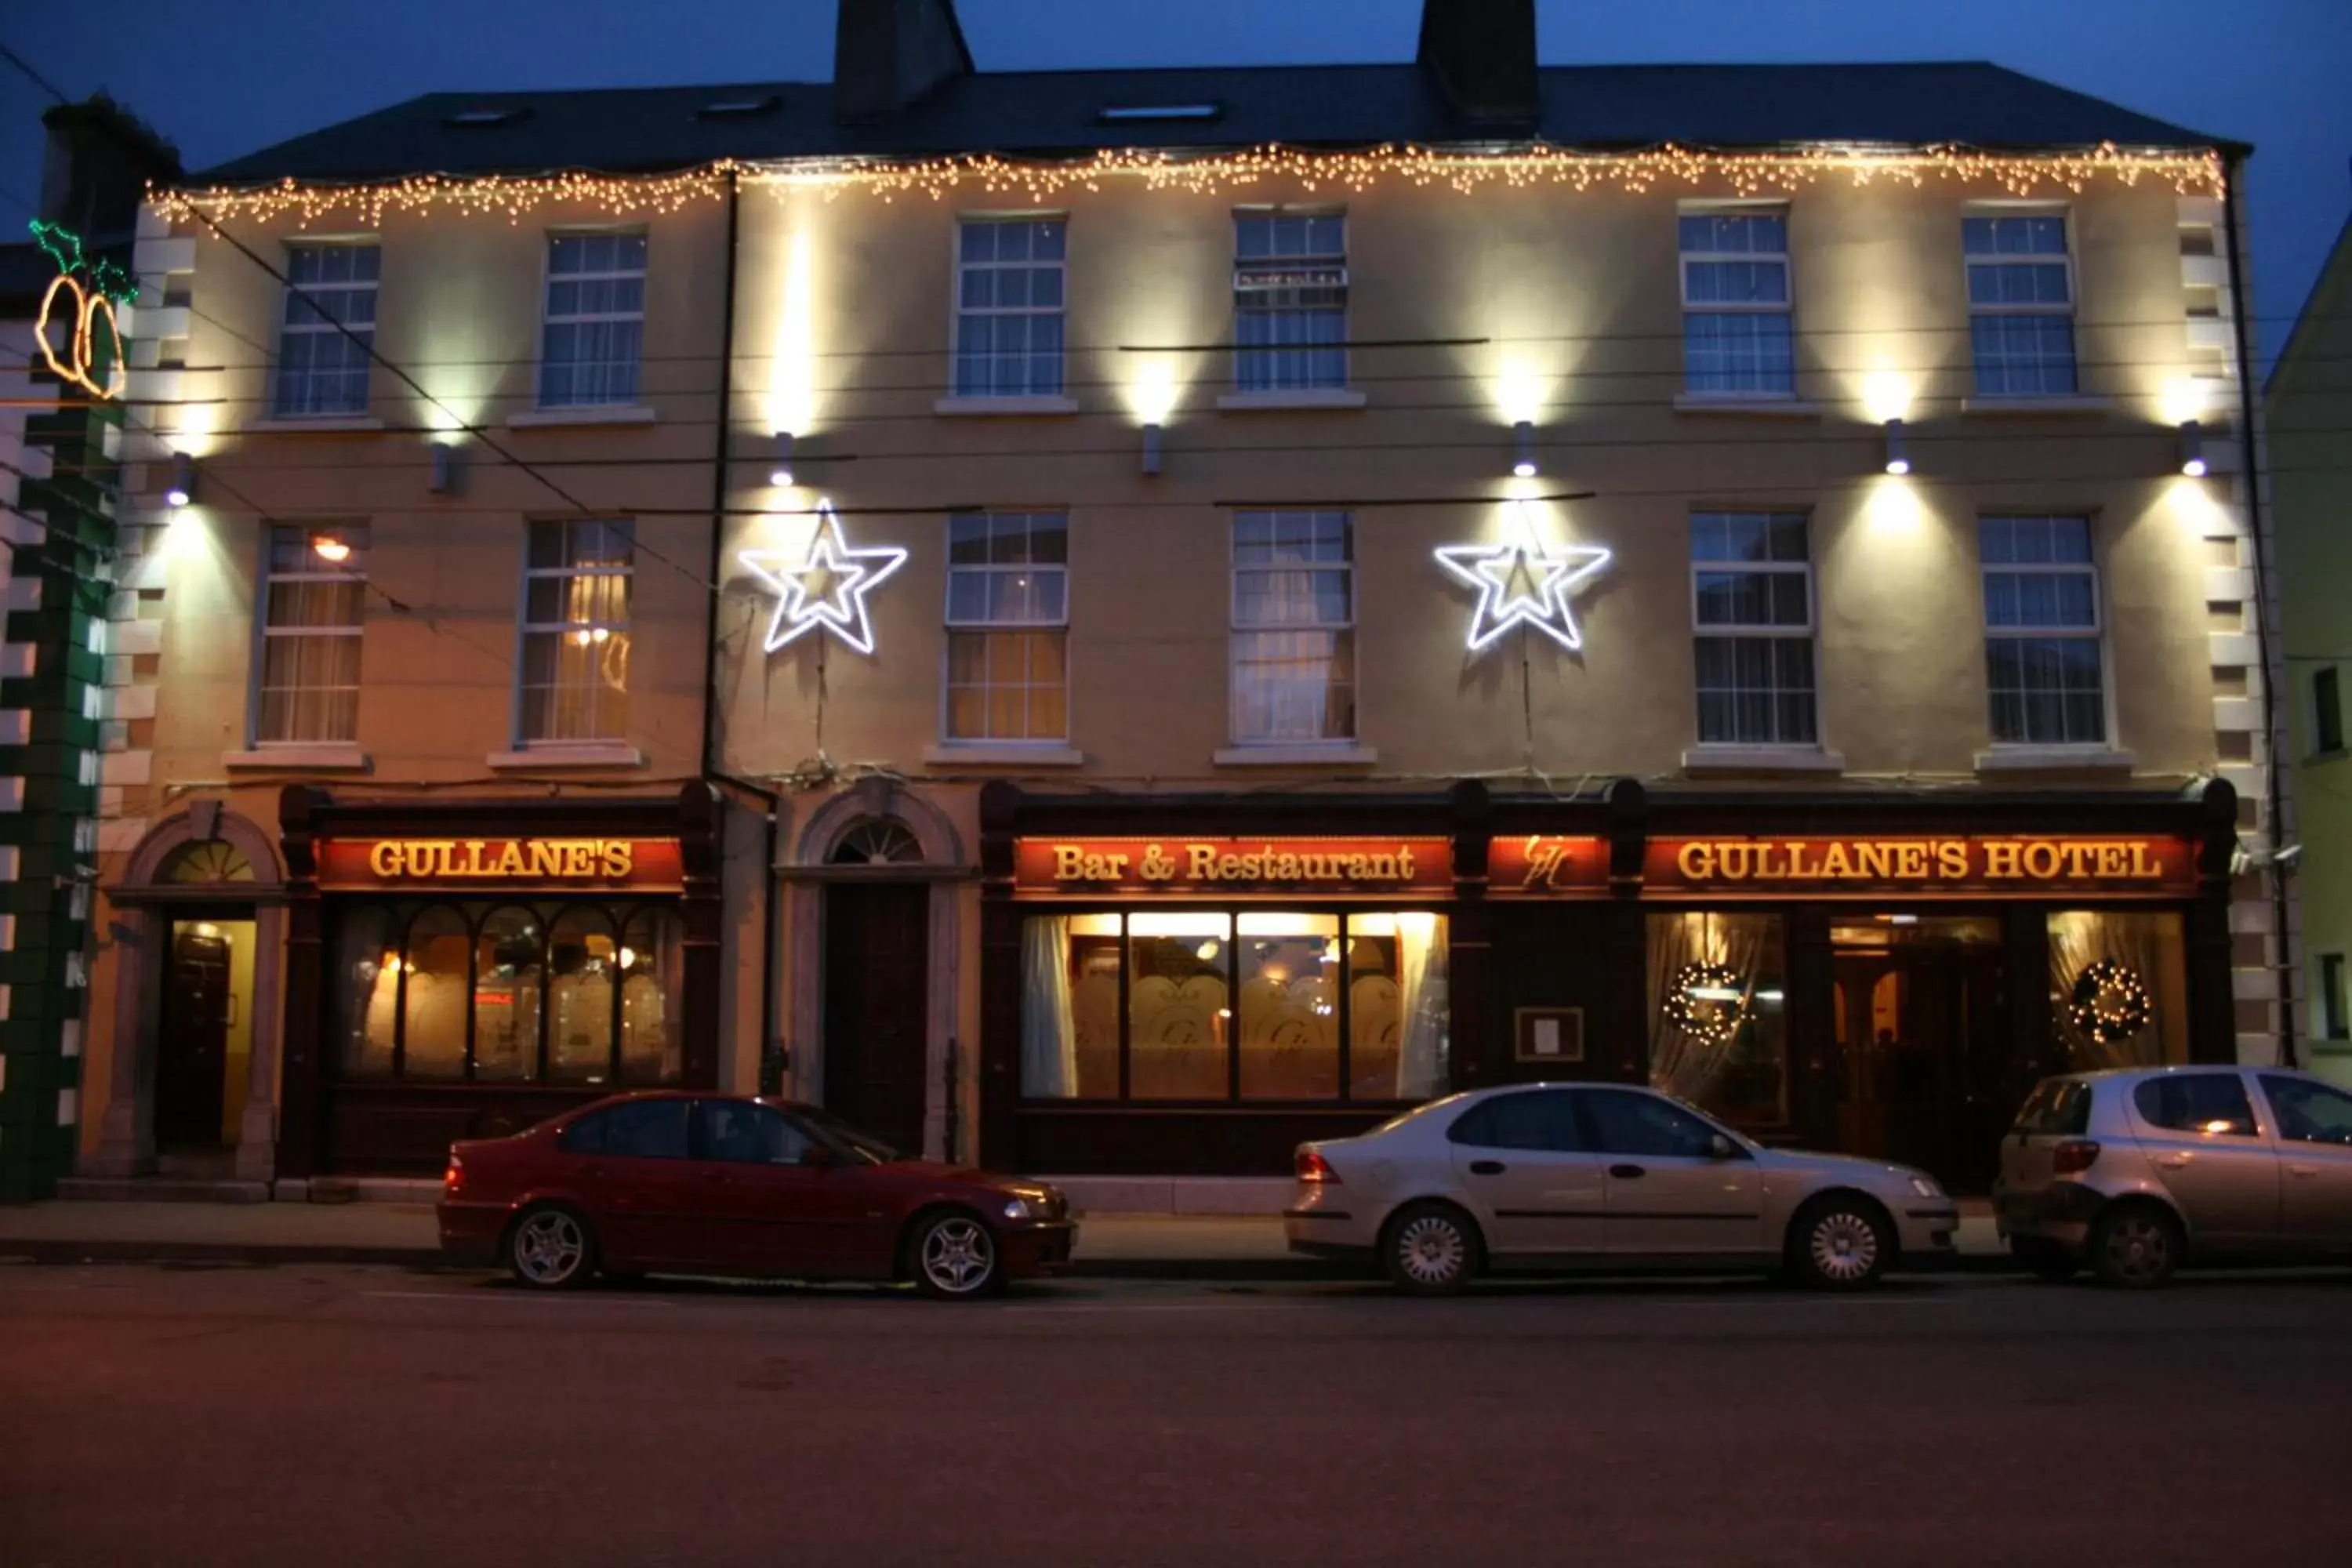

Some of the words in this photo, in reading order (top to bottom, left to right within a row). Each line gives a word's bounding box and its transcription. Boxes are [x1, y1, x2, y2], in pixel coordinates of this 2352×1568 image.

[370, 840, 632, 877] GULLANE'S
[1053, 844, 1129, 880] Bar
[1139, 843, 1175, 880] &
[1187, 844, 1415, 880] Restaurant
[1679, 842, 1968, 879] GULLANE'S
[1984, 842, 2162, 877] HOTEL
